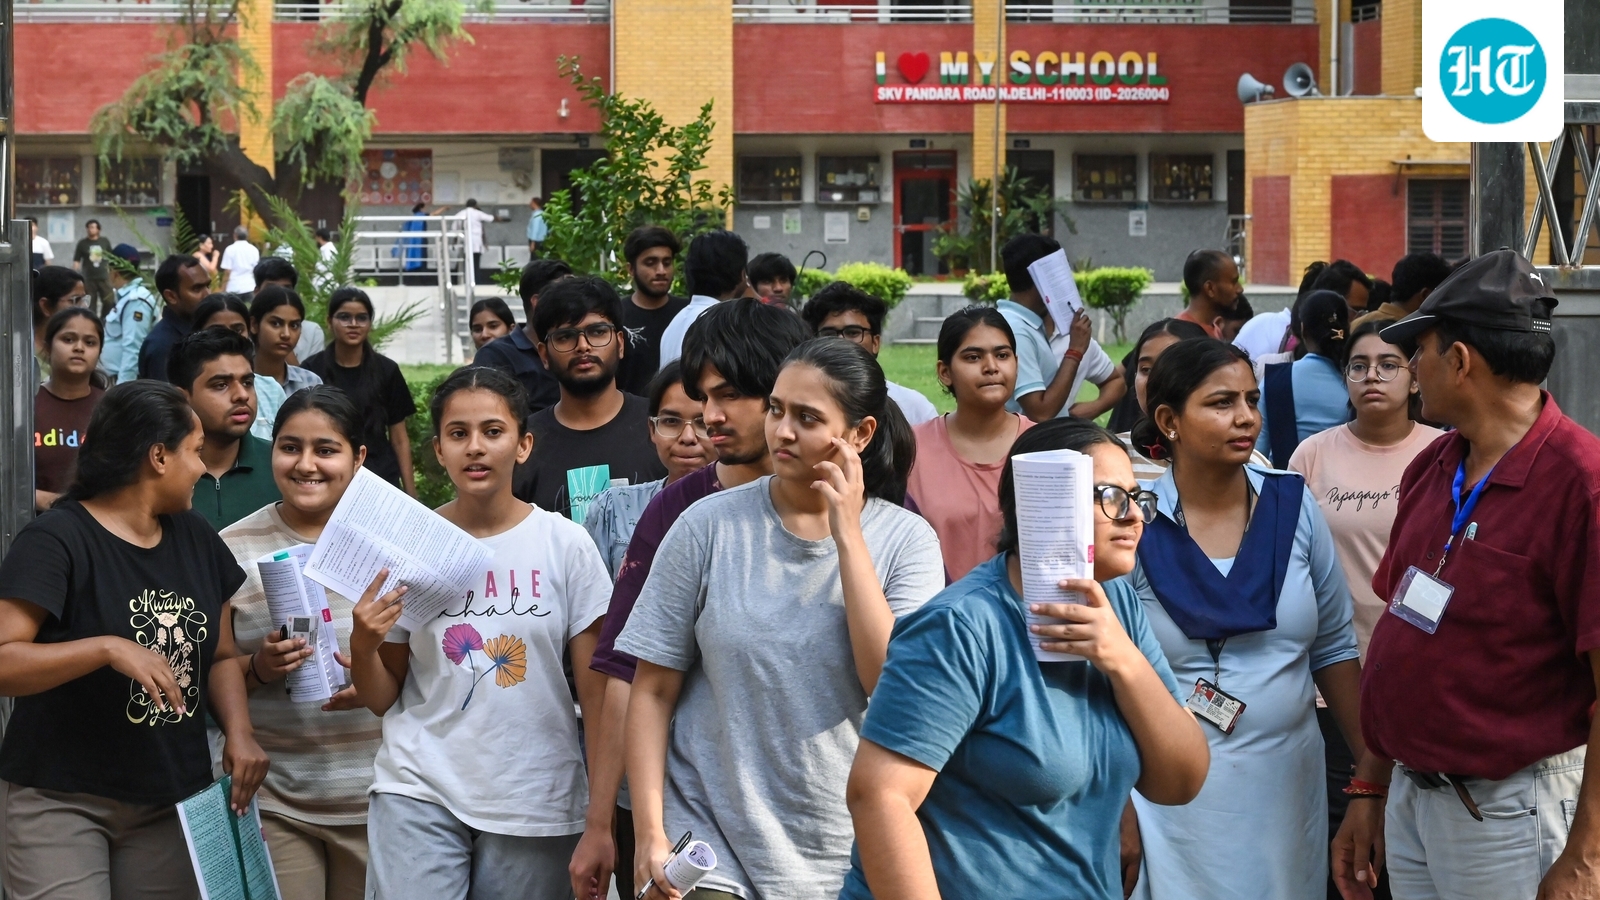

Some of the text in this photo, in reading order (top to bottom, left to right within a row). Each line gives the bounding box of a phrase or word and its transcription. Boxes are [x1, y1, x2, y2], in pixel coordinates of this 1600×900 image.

[876, 50, 1167, 85] I MY SCHOOL
[877, 87, 903, 101] SKV
[905, 87, 961, 101] PANDARA
[963, 87, 996, 101] ROAD
[1325, 486, 1390, 512] Papagayo
